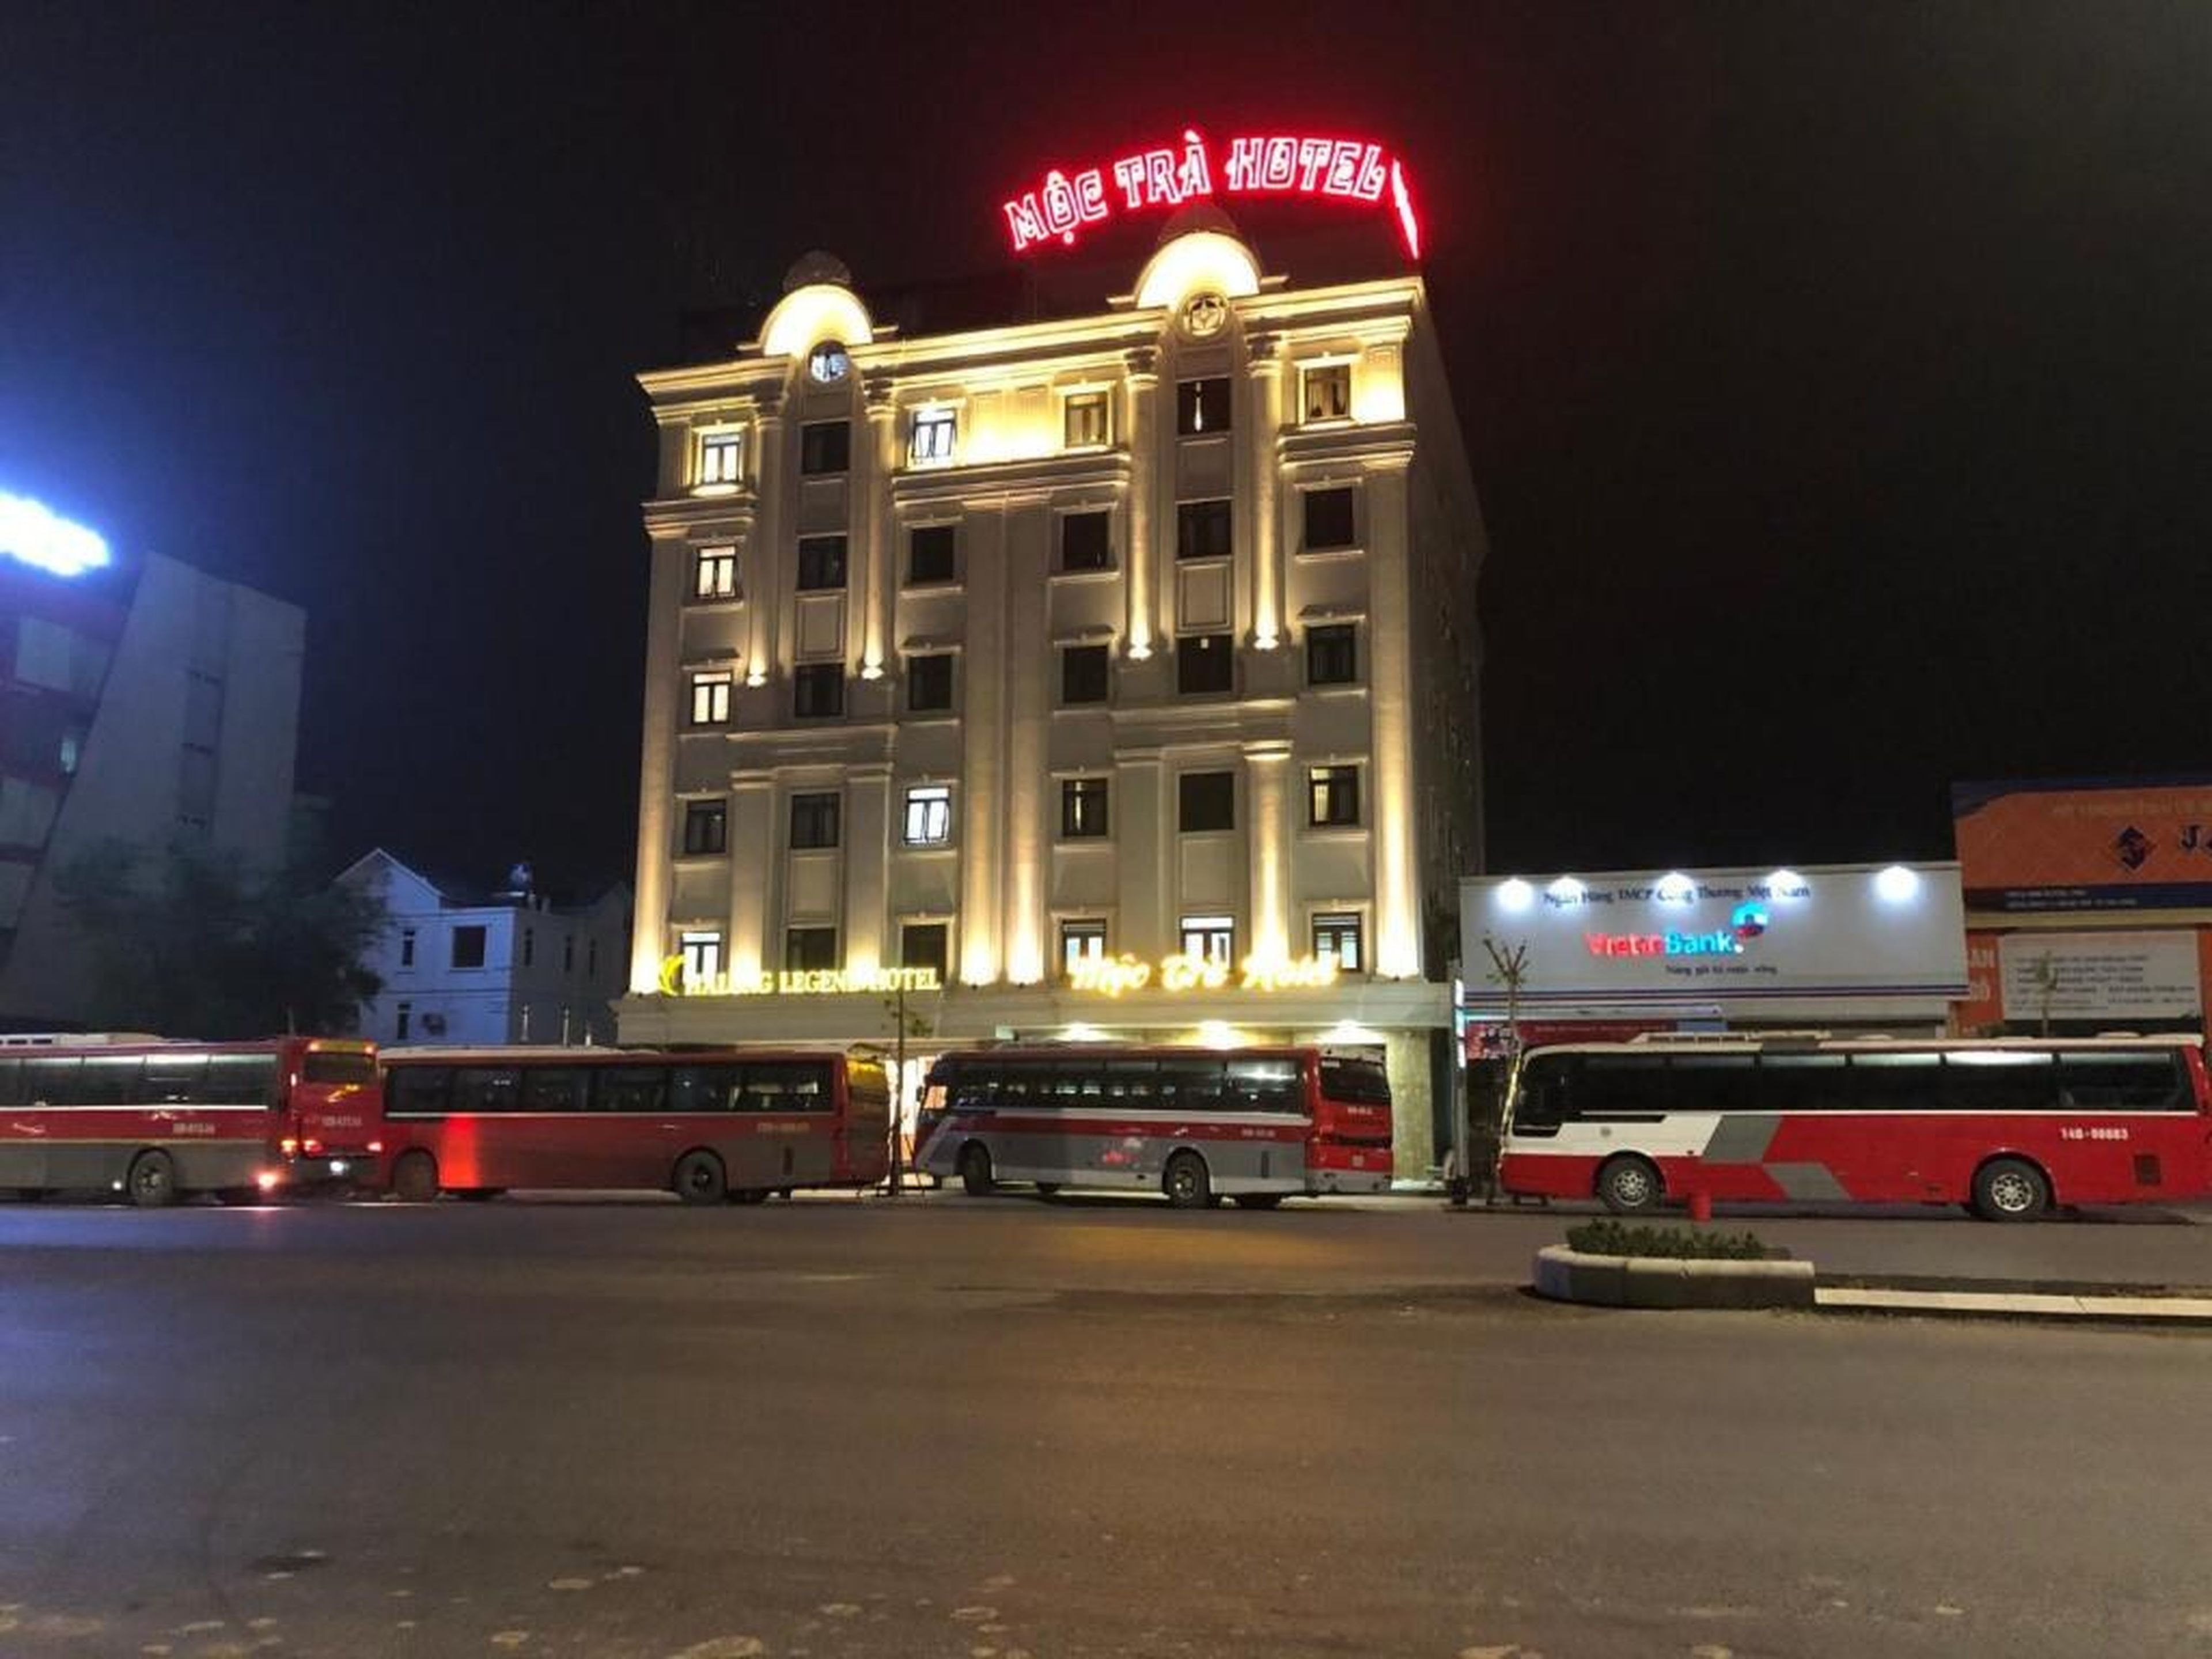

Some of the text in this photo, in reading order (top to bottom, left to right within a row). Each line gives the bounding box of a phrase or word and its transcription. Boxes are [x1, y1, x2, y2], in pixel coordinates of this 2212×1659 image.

[1004, 130, 1384, 249] MỘC TRÀ HOTEL
[1657, 888, 1694, 904] Cg
[1585, 930, 1732, 956] VietinBank
